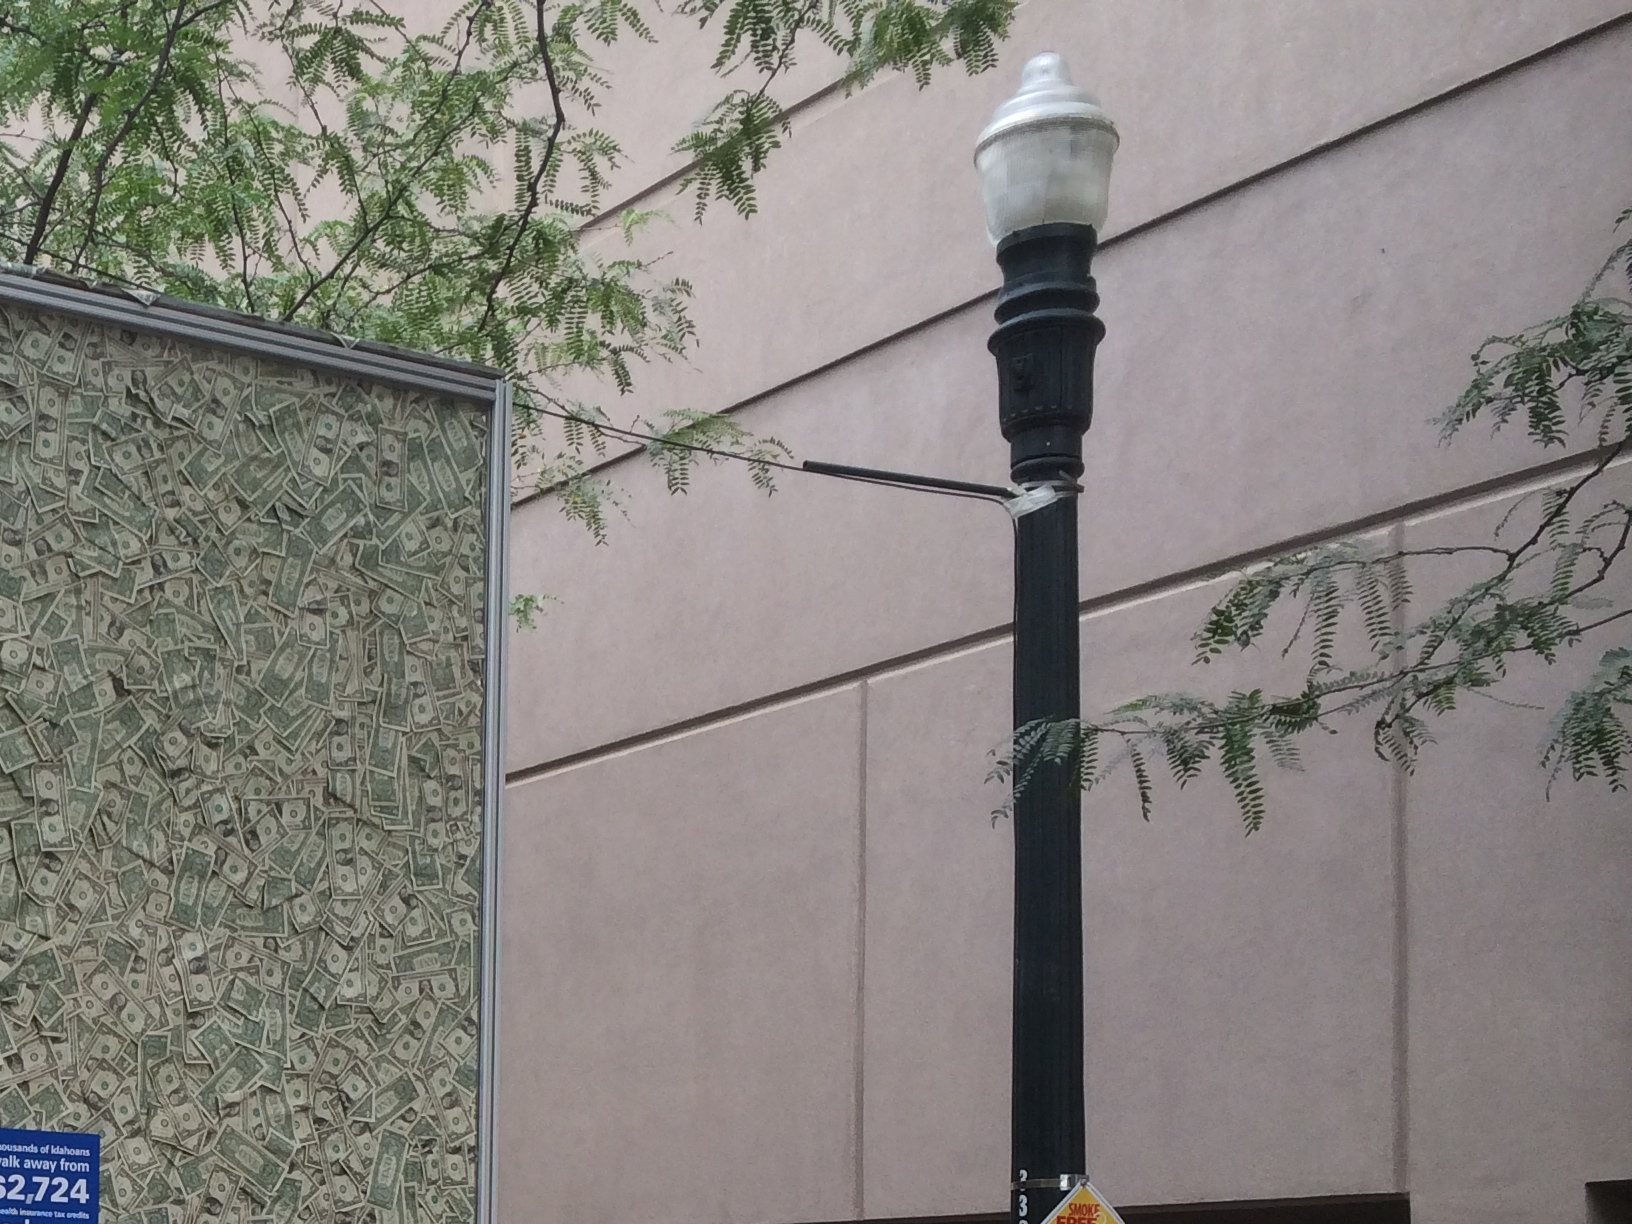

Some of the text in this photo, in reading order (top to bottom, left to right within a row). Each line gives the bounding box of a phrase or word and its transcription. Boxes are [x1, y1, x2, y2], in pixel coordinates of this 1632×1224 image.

[40, 1145, 49, 1154] of
[51, 1145, 90, 1156] Idahoans
[24, 1159, 57, 1173] away
[60, 1158, 89, 1172] from
[20, 1208, 52, 1218] insurance
[54, 1210, 65, 1218] tax
[67, 1210, 89, 1219] credits
[1069, 1203, 1100, 1217] SMOKE
